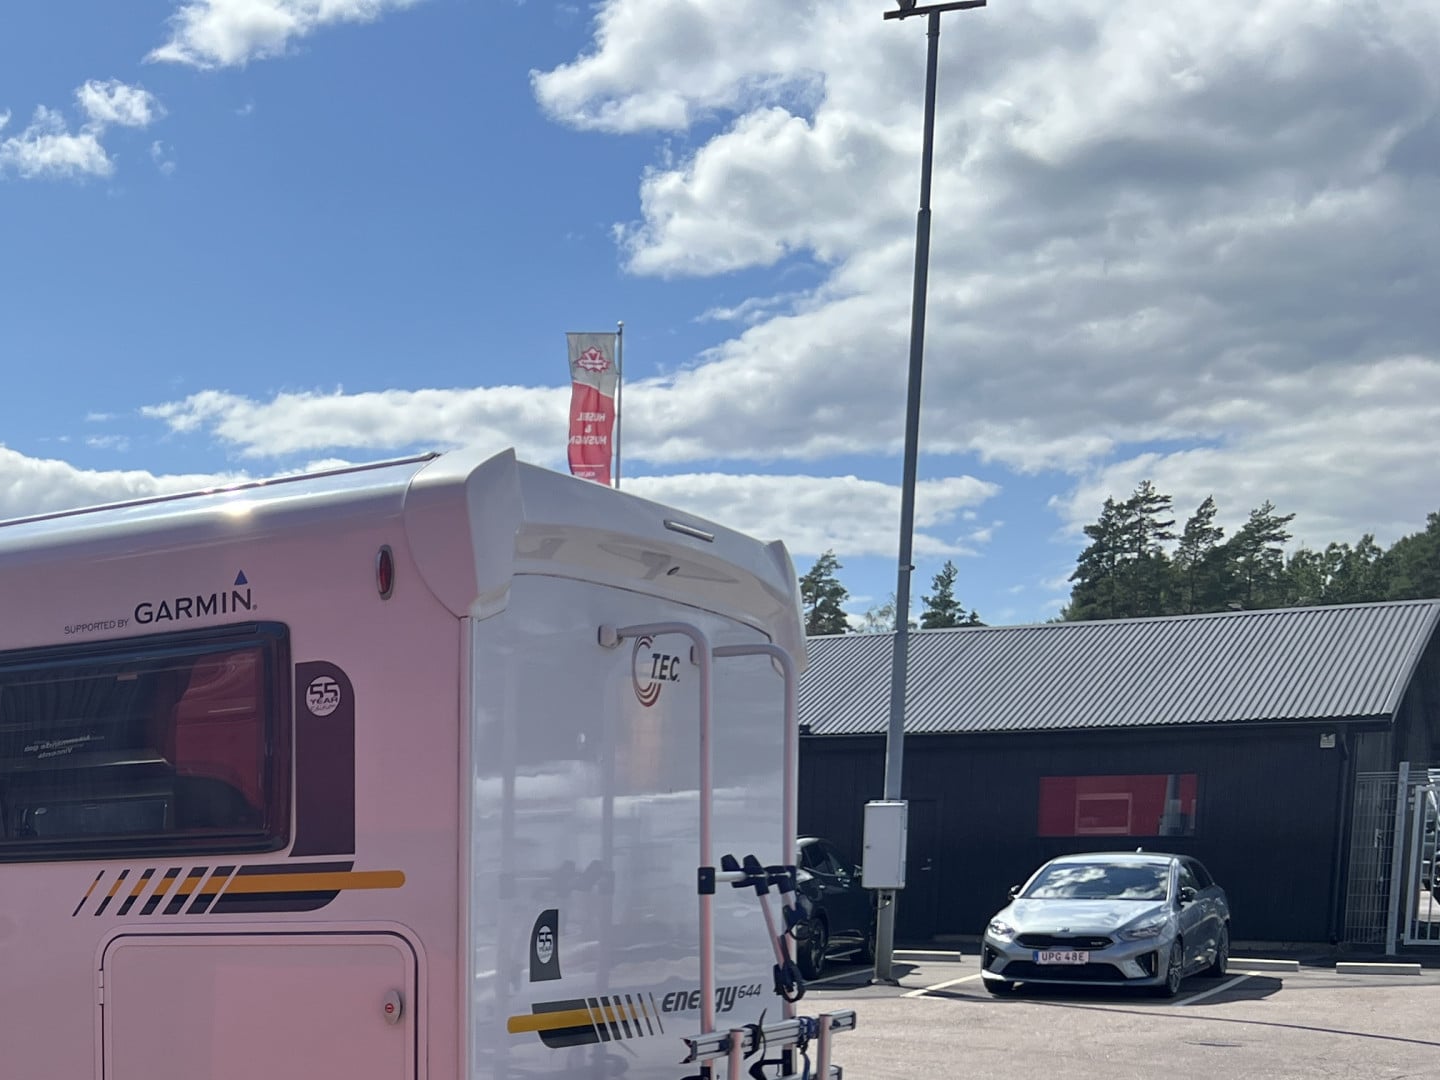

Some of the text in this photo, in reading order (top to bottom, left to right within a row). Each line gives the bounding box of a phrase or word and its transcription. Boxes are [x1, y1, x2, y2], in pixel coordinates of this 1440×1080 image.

[134, 588, 252, 625] GARMIN
[64, 619, 129, 635] SUPPORTED BY
[310, 682, 338, 698] 55
[662, 984, 762, 1013] enegy 644
